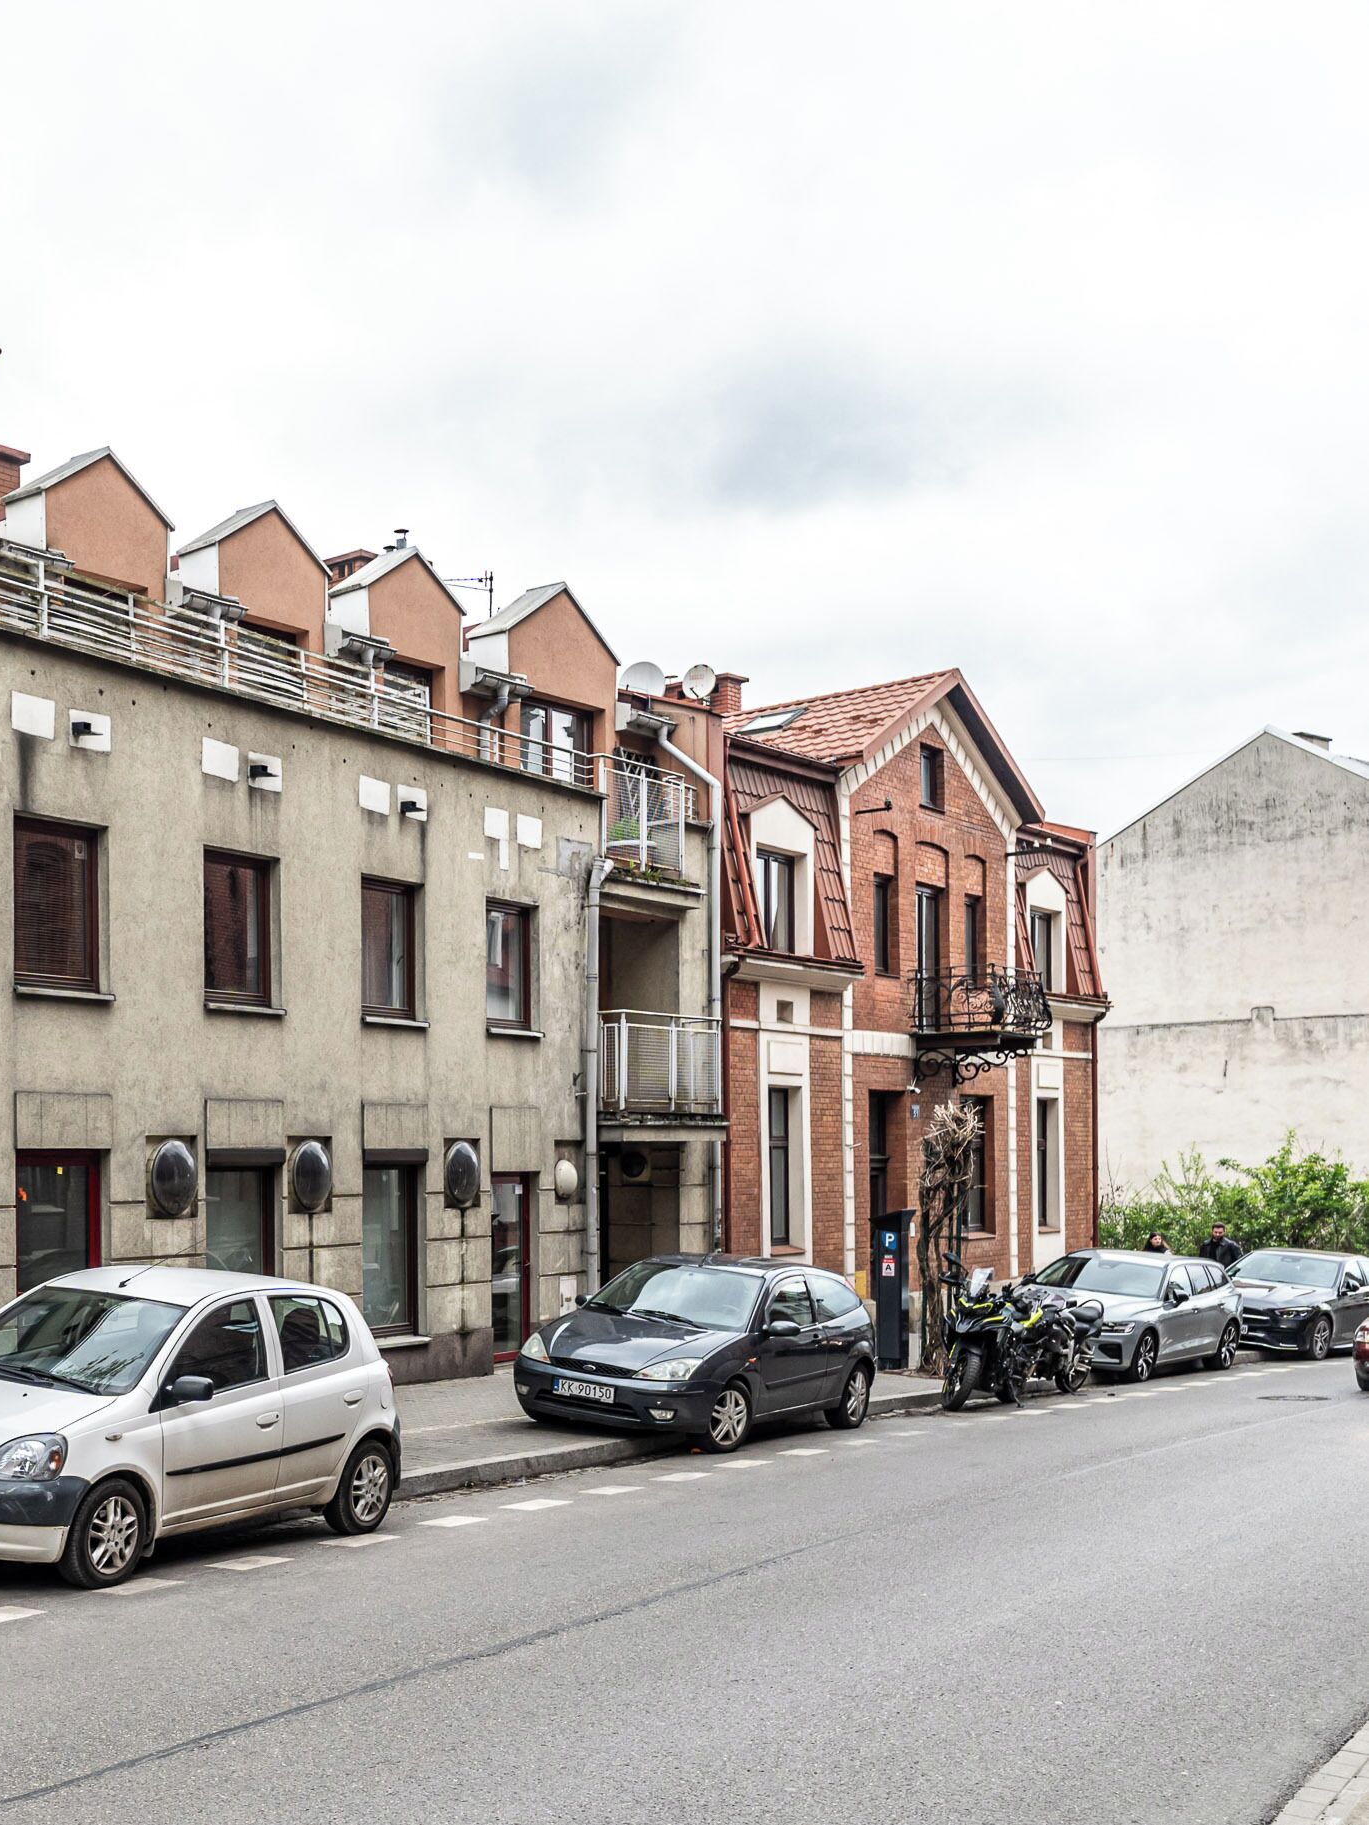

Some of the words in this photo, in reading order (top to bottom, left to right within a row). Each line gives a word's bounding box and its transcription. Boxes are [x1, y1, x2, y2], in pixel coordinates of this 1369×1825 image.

[885, 1233, 895, 1247] P
[561, 1380, 574, 1393] KK
[578, 1383, 611, 1400] 90150
